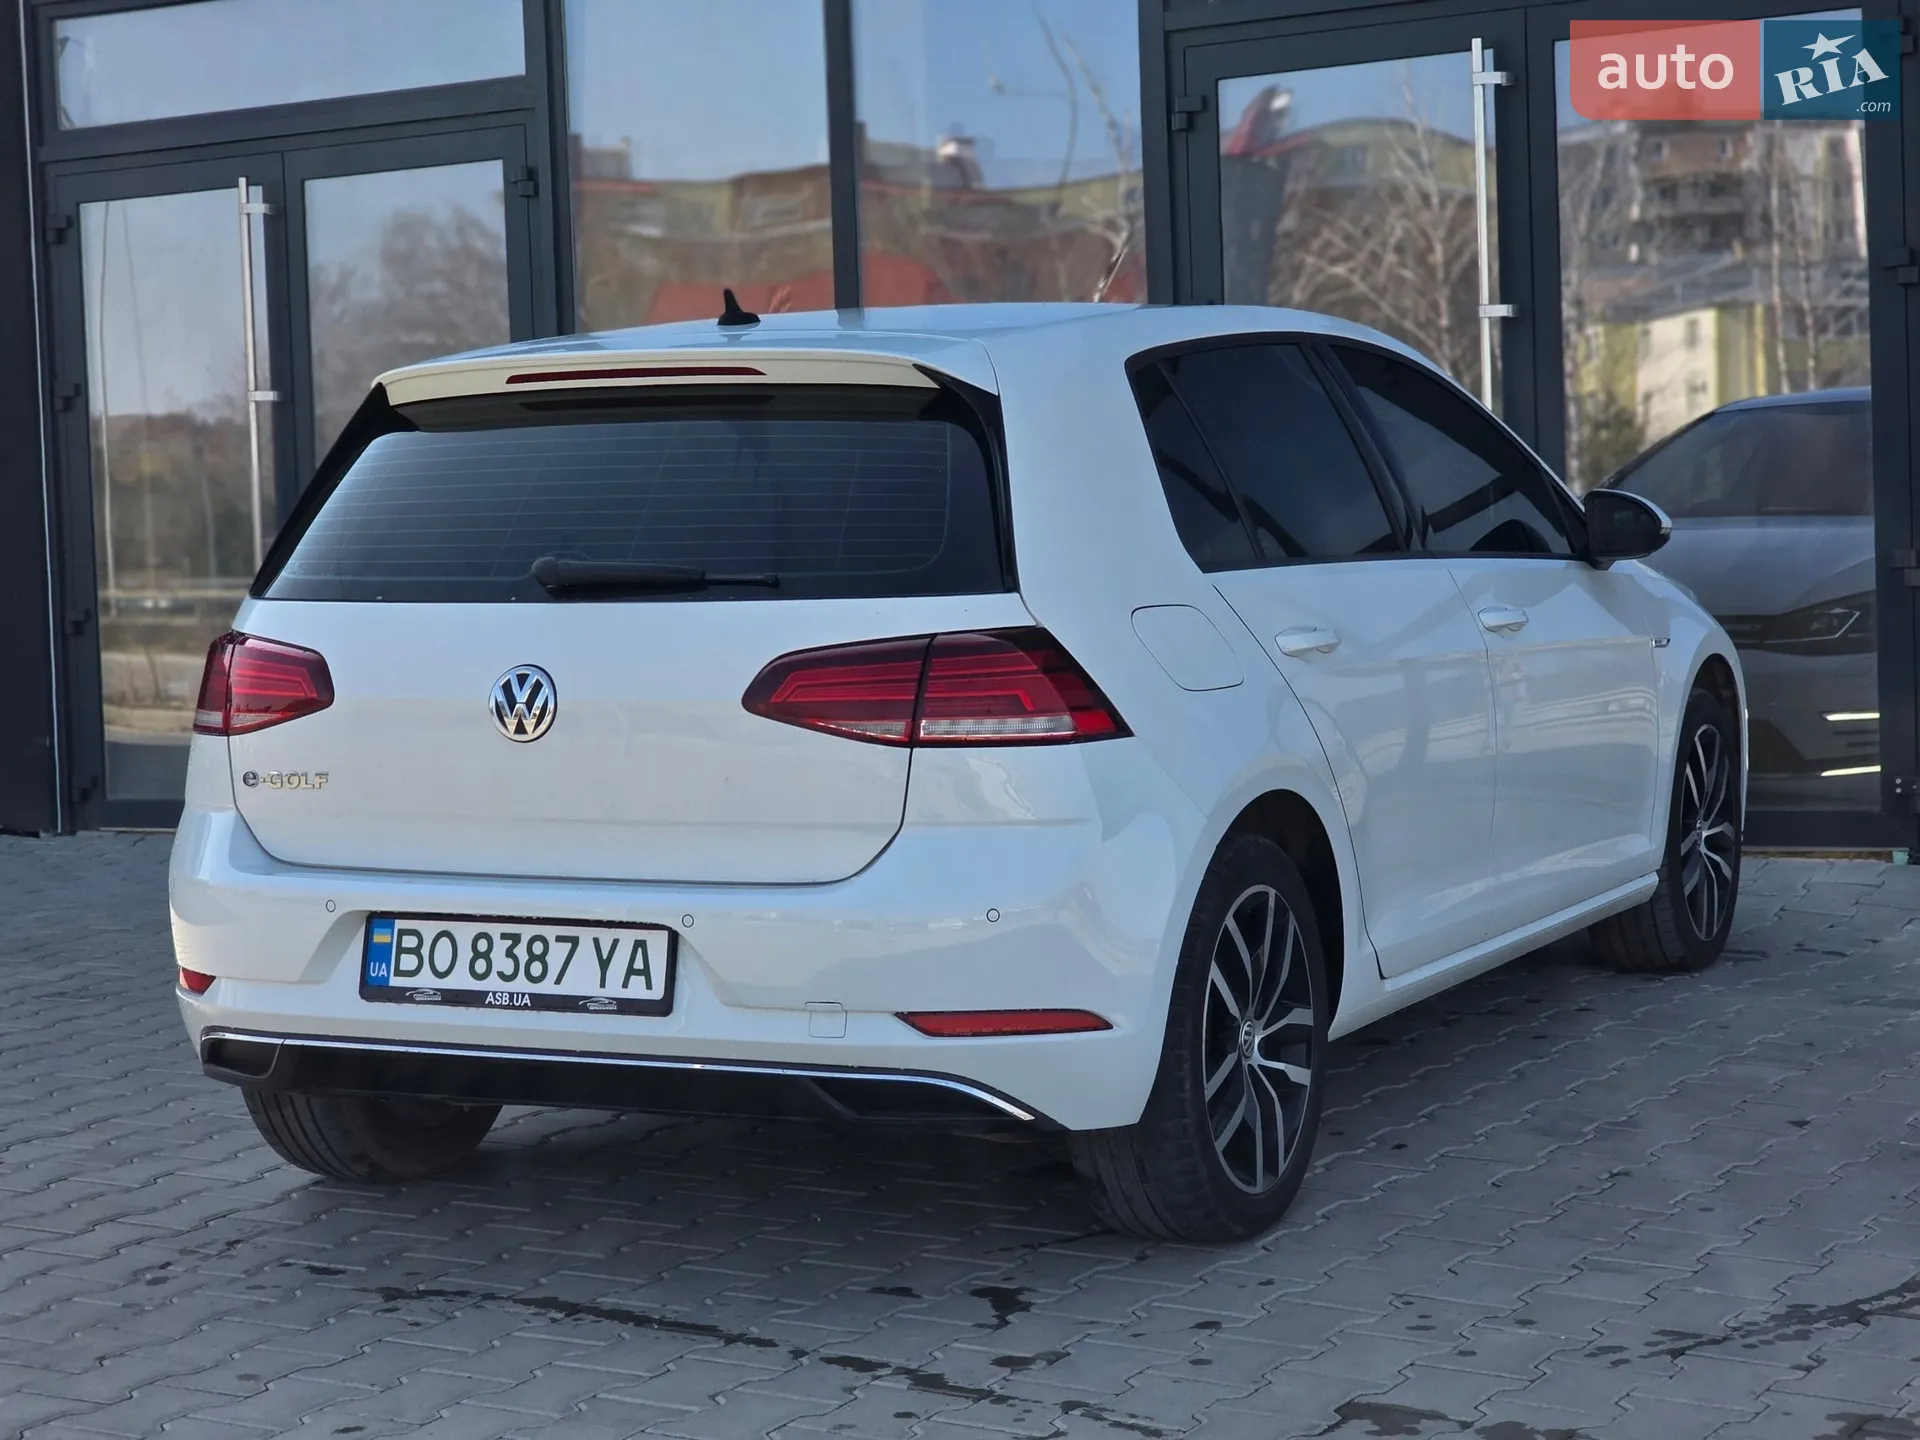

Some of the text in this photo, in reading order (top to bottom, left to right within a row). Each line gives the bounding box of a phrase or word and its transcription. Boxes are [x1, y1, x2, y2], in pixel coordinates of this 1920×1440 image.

[242, 770, 329, 790] e-GOLF
[393, 928, 653, 991] BO 8387 YA
[370, 961, 388, 978] UA
[485, 991, 531, 1007] ASB.UA
